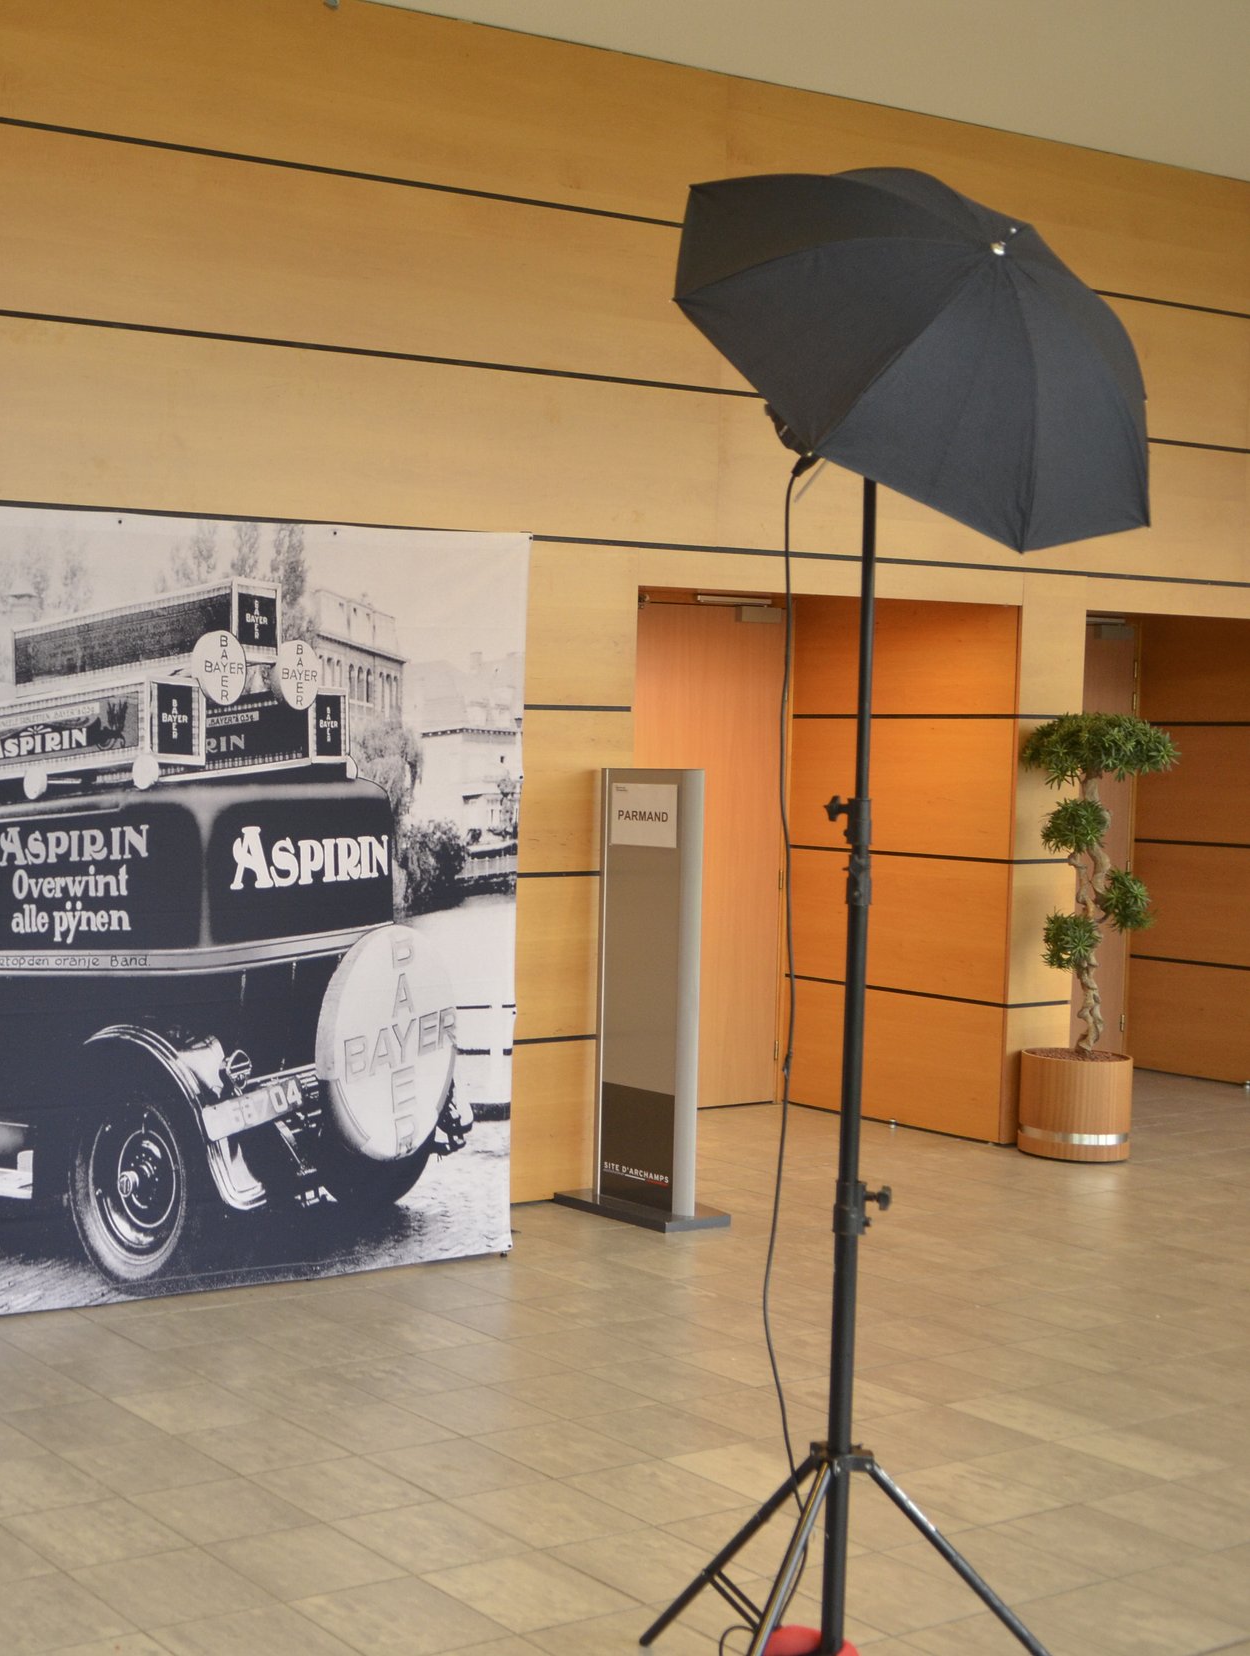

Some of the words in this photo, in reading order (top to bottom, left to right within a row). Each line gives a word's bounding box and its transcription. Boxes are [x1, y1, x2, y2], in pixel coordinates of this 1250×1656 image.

[246, 613, 268, 625] BAYER
[204, 660, 244, 674] BAYER
[219, 635, 229, 701] BAYER
[281, 668, 318, 681] BAYER
[296, 644, 304, 706] BAYER
[162, 713, 188, 723] BAYER
[319, 719, 338, 728] BAYER
[618, 810, 668, 822] PARMAND
[0, 825, 149, 866] ASPIRIN
[230, 826, 388, 890] ASPIRIN
[12, 864, 128, 899] Overwint
[11, 904, 49, 933] alle
[55, 956, 100, 969] oranje
[344, 1006, 457, 1083] BAYER
[604, 1161, 620, 1172] SITE
[622, 1165, 669, 1183] D'ARCHAMPS
